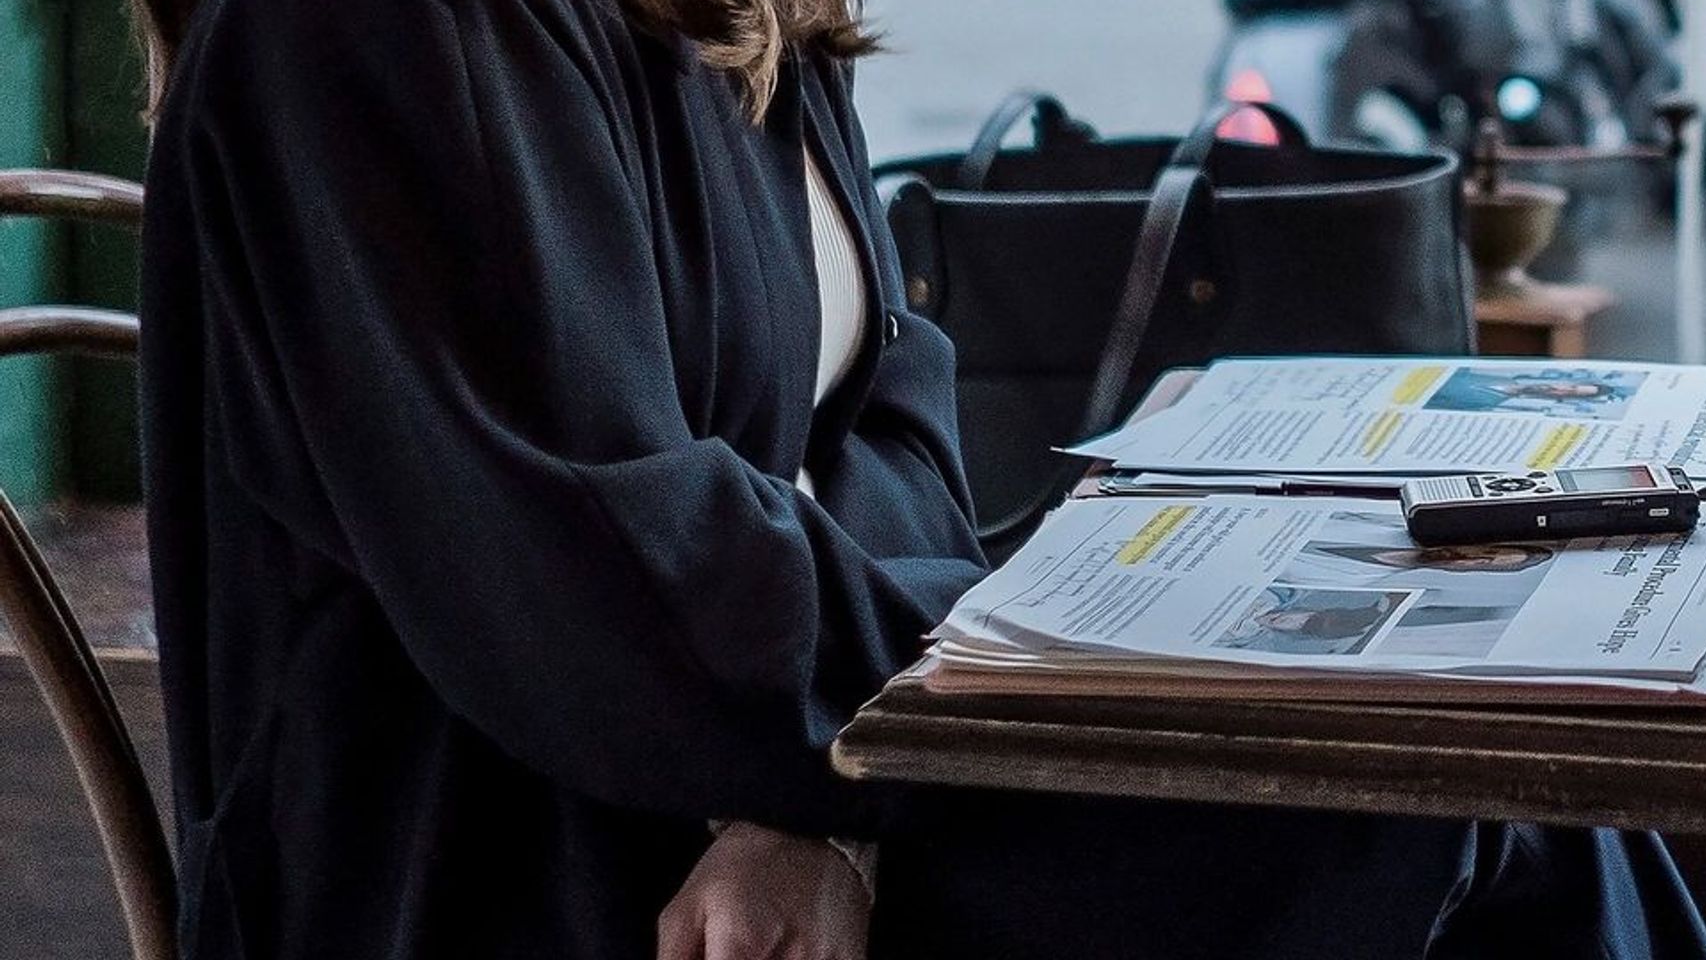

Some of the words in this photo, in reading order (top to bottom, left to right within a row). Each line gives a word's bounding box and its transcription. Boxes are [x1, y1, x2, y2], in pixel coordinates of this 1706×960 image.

[1603, 552, 1648, 577] Family
[1631, 566, 1678, 606] Procedure
[1616, 606, 1651, 628] Gives
[1597, 628, 1639, 654] Hope
